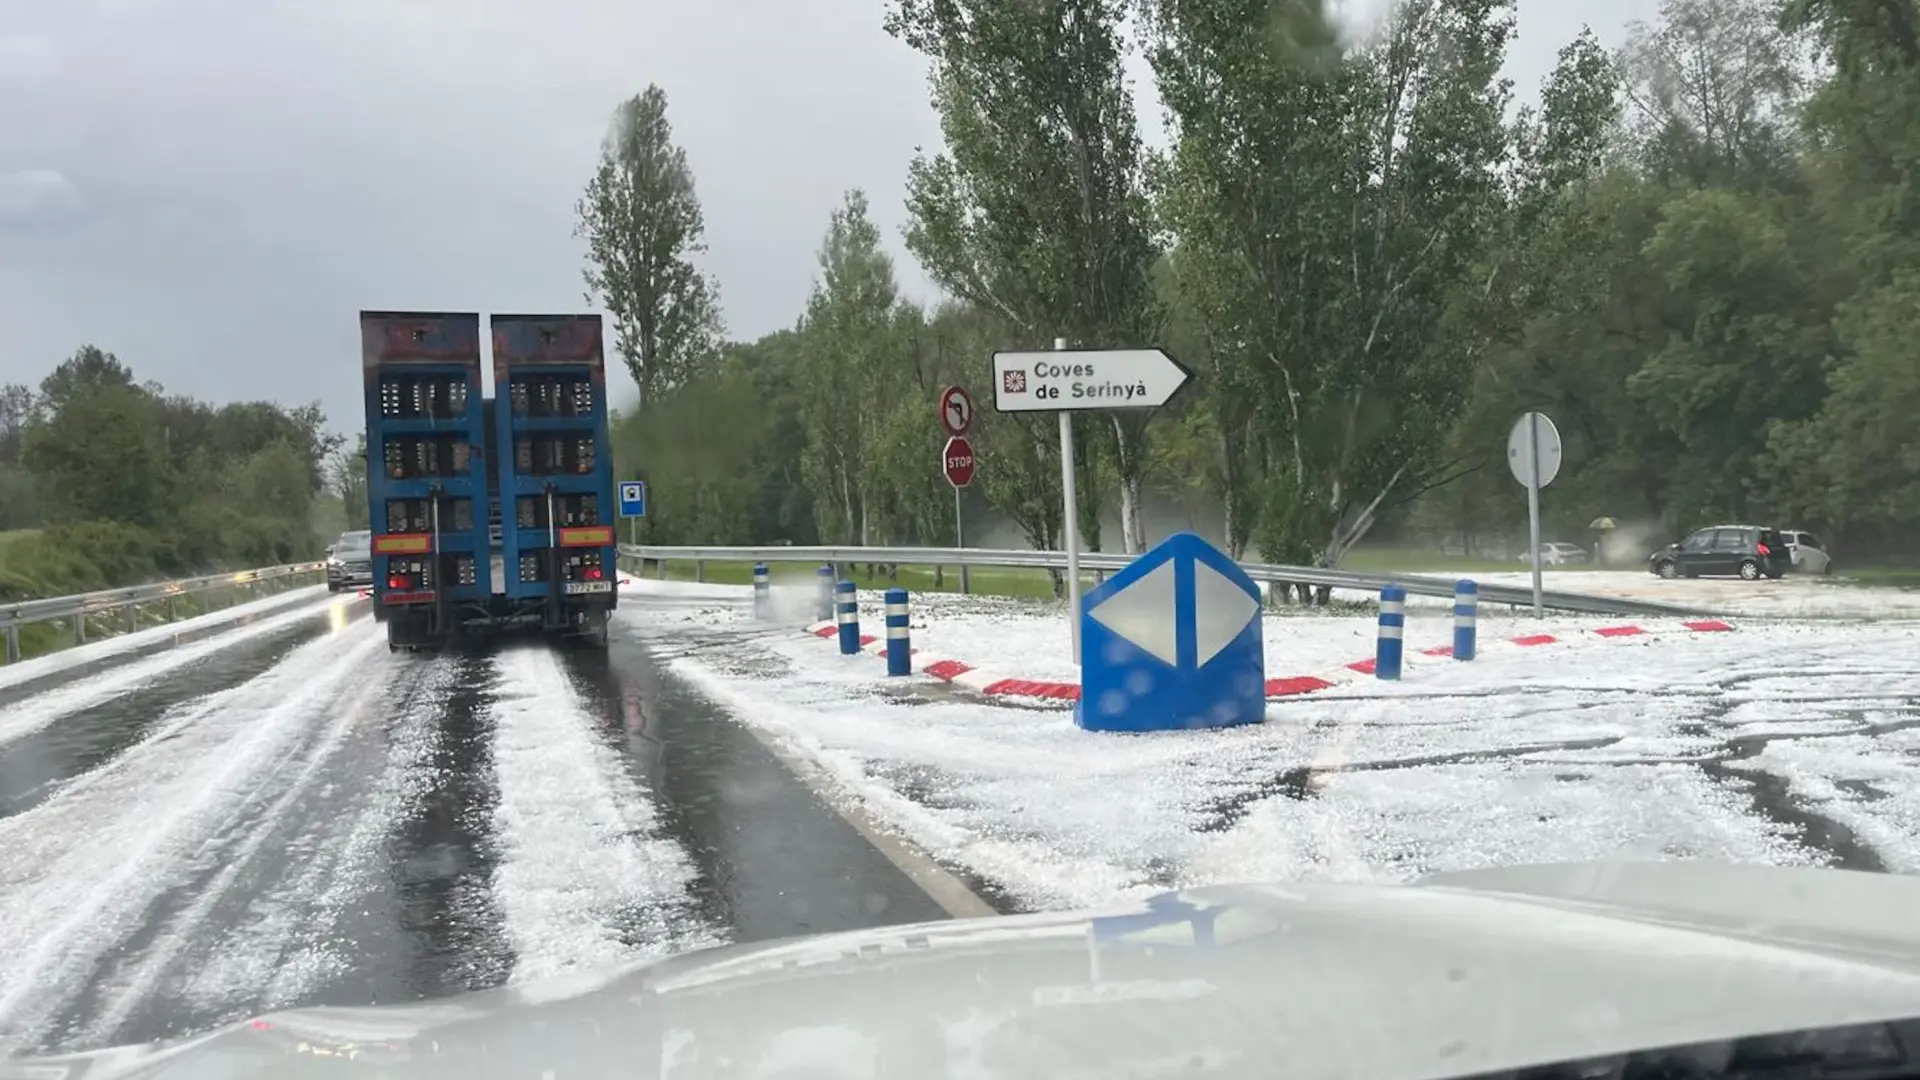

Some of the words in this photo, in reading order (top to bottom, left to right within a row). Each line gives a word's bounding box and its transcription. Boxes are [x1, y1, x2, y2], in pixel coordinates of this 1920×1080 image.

[1034, 361, 1095, 378] Coves
[1035, 384, 1060, 399] de
[1071, 380, 1147, 400] Serinyà
[948, 455, 972, 468] STOP
